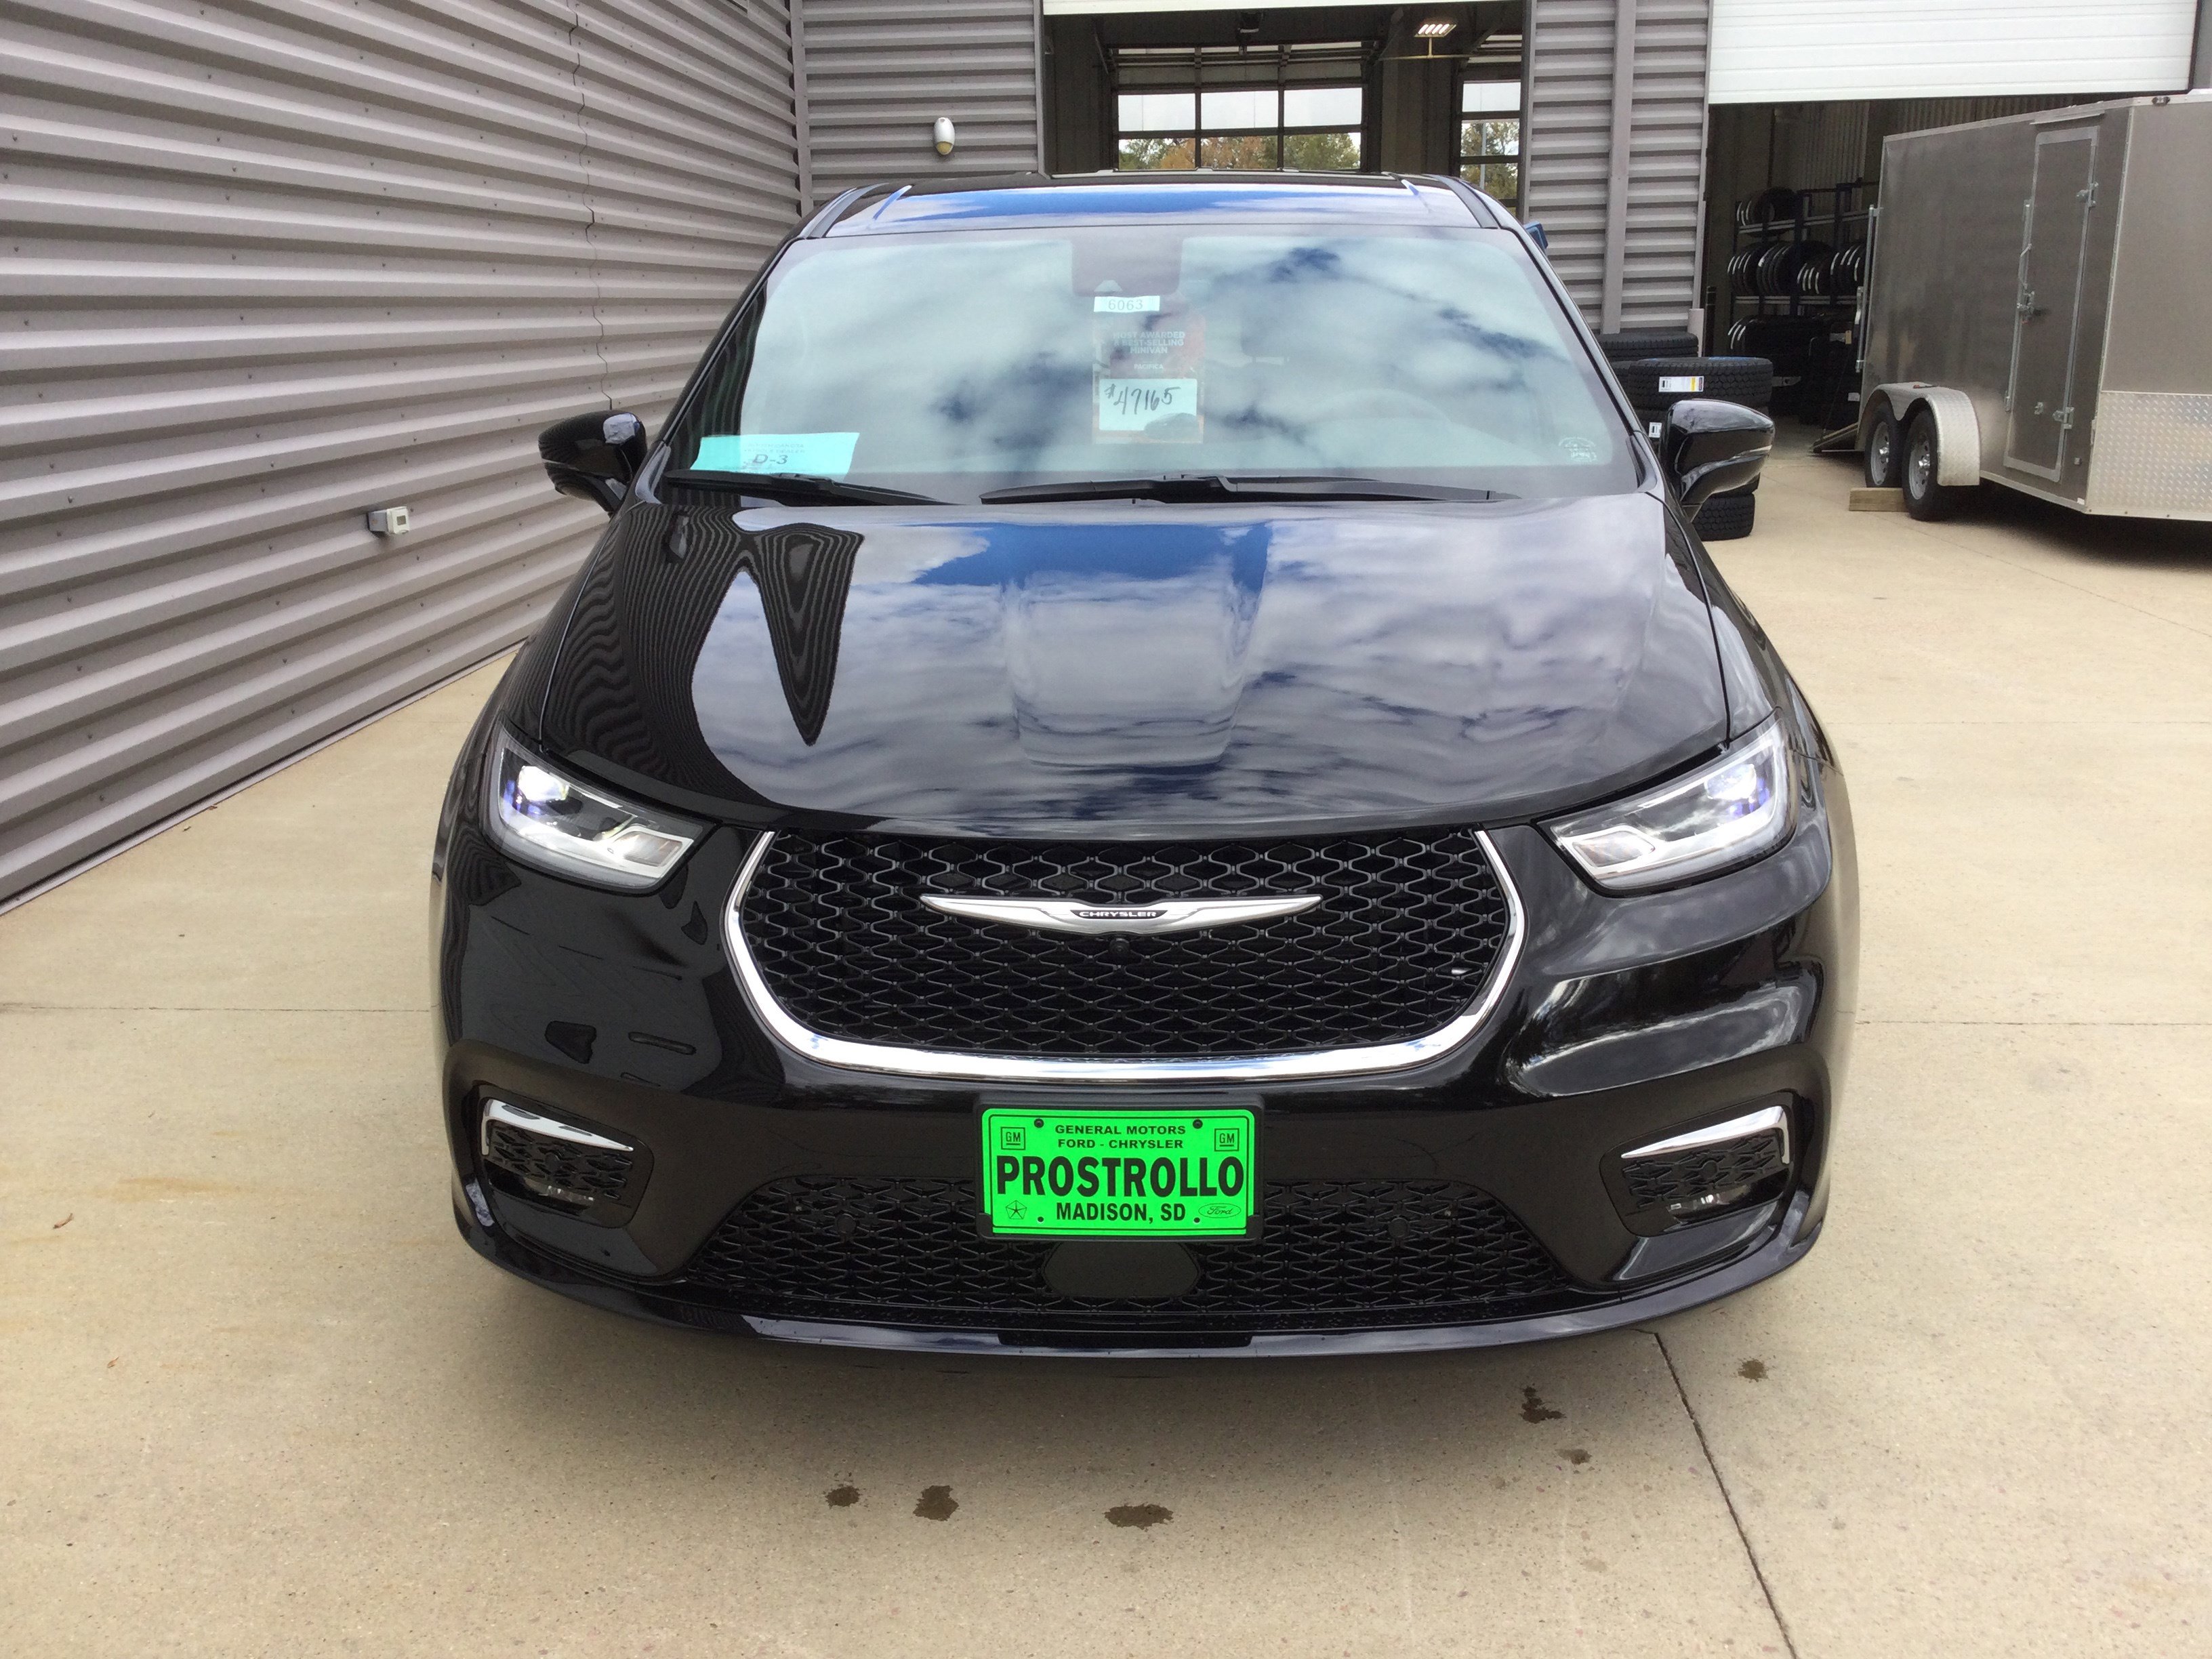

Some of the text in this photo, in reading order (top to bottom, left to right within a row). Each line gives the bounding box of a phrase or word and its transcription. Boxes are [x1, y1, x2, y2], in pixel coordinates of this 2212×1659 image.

[1108, 299, 1143, 310] 6063
[752, 454, 788, 464] D-3
[1055, 1125, 1186, 1135] GENERAL MOTORS
[1006, 1132, 1021, 1142] GM
[1219, 1132, 1235, 1143] GM
[1058, 1139, 1096, 1148] FORD
[1110, 1139, 1183, 1149] CHRYSLER
[997, 1155, 1244, 1197] PROSTROLLO
[1057, 1203, 1185, 1224] MADISON, SD
[1206, 1206, 1233, 1215] Ford
